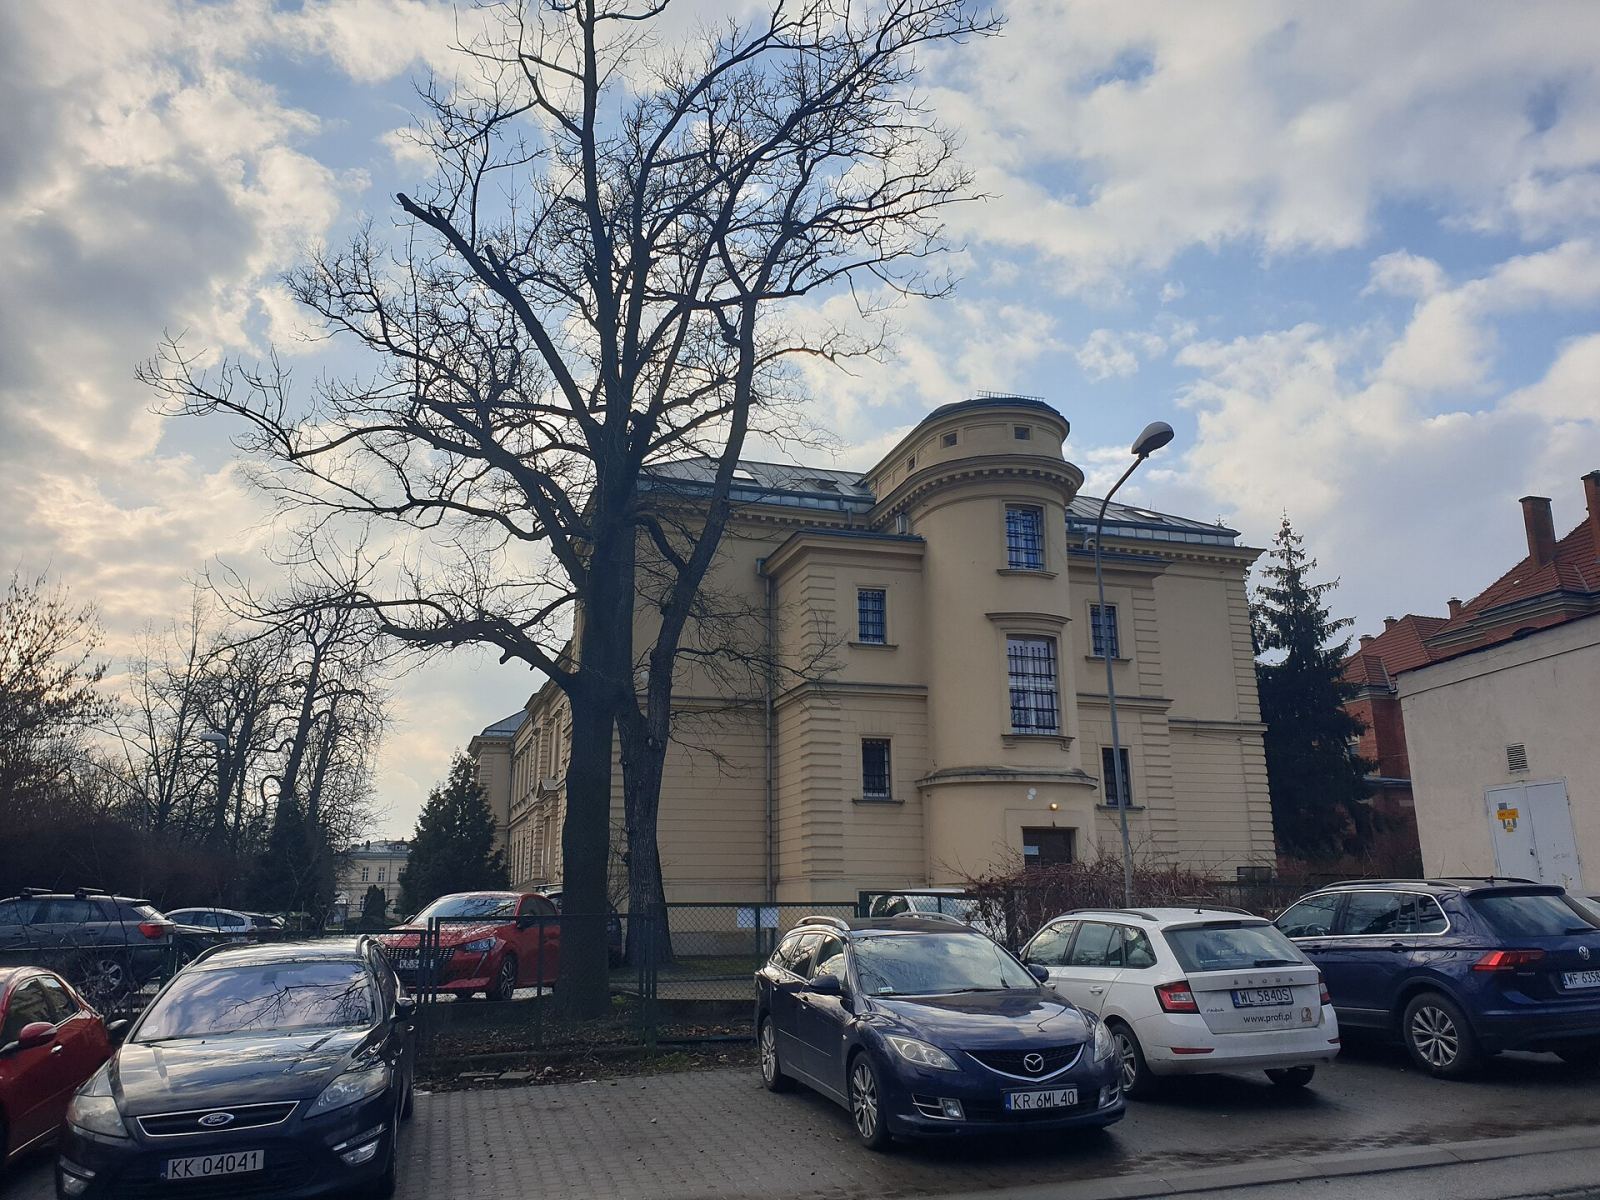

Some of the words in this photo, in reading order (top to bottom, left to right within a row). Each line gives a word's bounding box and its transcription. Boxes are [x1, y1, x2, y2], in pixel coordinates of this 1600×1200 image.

[1566, 973, 1577, 985] WF
[1239, 991, 1255, 1003] WL
[1256, 988, 1290, 1002] 5840S
[1243, 1011, 1293, 1023] www.profi.pl
[1013, 1094, 1031, 1109] KR
[1036, 1090, 1075, 1108] 6ML40
[171, 1159, 194, 1178] KK
[202, 1152, 258, 1175] 04041
